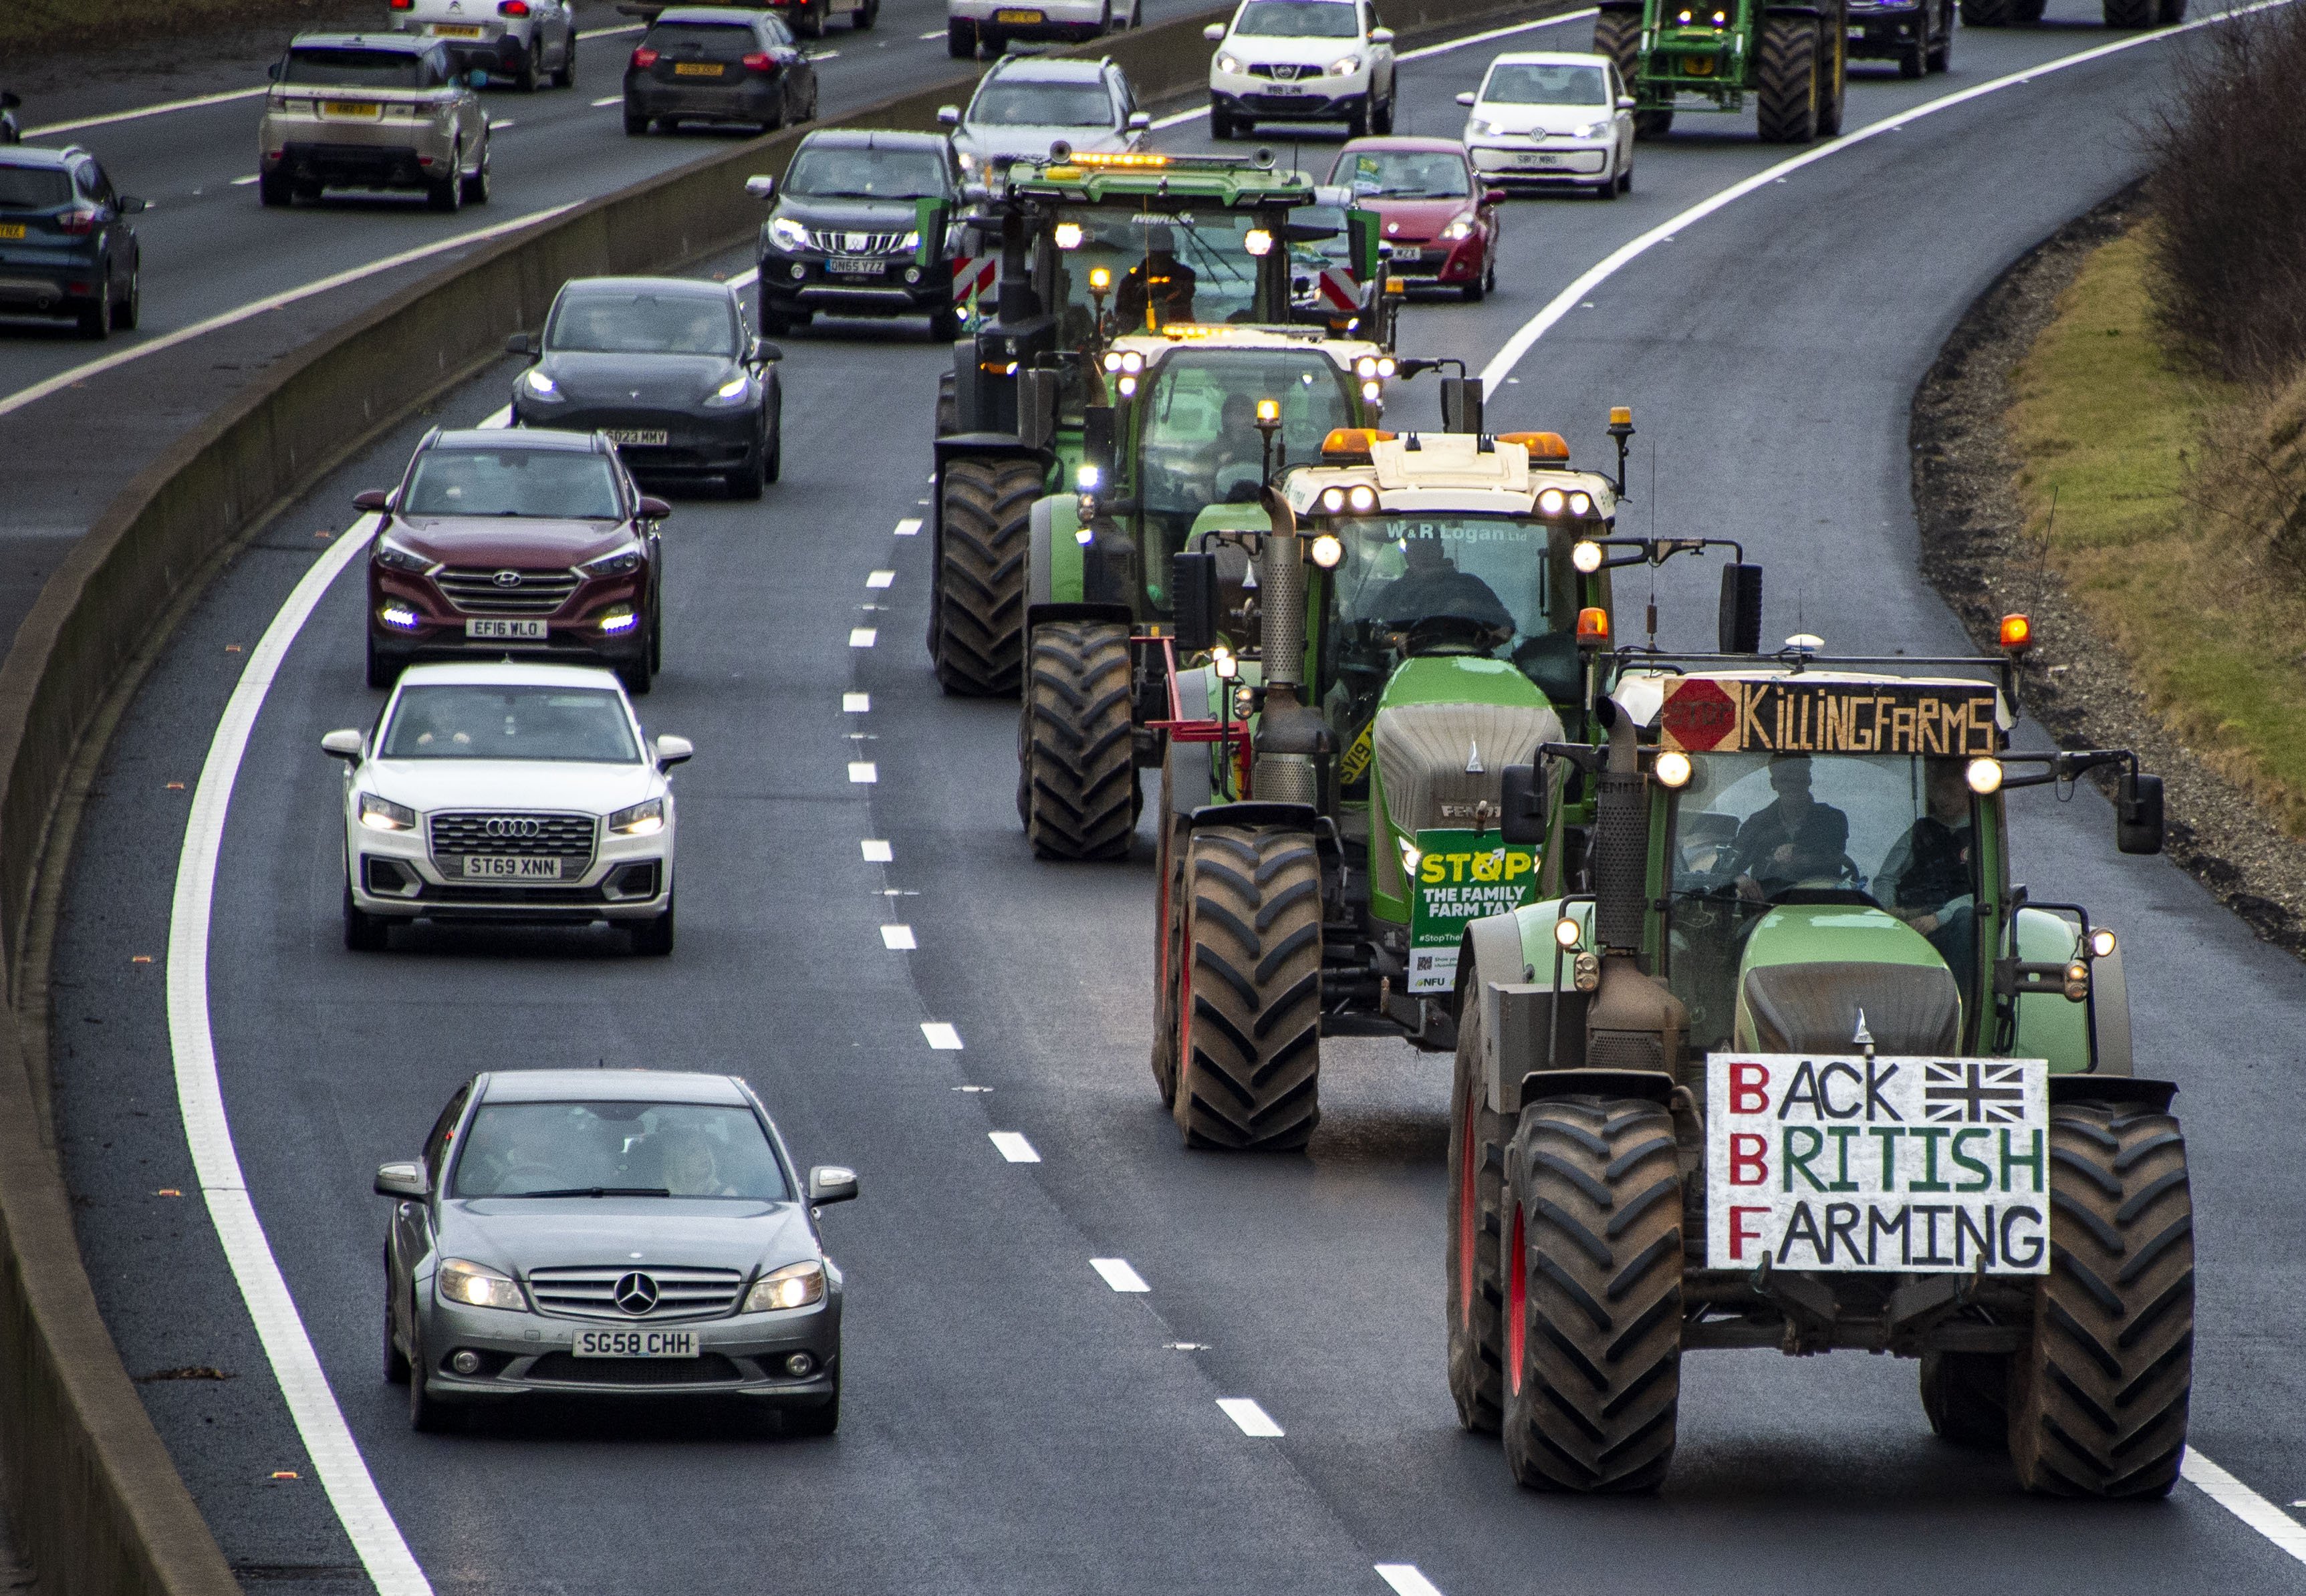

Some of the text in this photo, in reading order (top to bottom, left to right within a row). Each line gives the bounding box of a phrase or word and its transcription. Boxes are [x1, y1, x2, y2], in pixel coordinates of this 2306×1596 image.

[1420, 524, 1434, 539] R
[1440, 524, 1504, 543] Logan
[475, 622, 505, 635] EF16
[471, 857, 553, 876] ST69 XNN
[1421, 851, 1531, 884] STOP
[1423, 886, 1527, 902] THE FAMILY
[1429, 903, 1479, 918] FARM
[1424, 978, 1445, 986] NFU
[1729, 1061, 1904, 1121] BACK
[1729, 1125, 2044, 1192] BRITISH
[1729, 1200, 2045, 1268] FARMING
[583, 1333, 690, 1353] SG58 CHH
